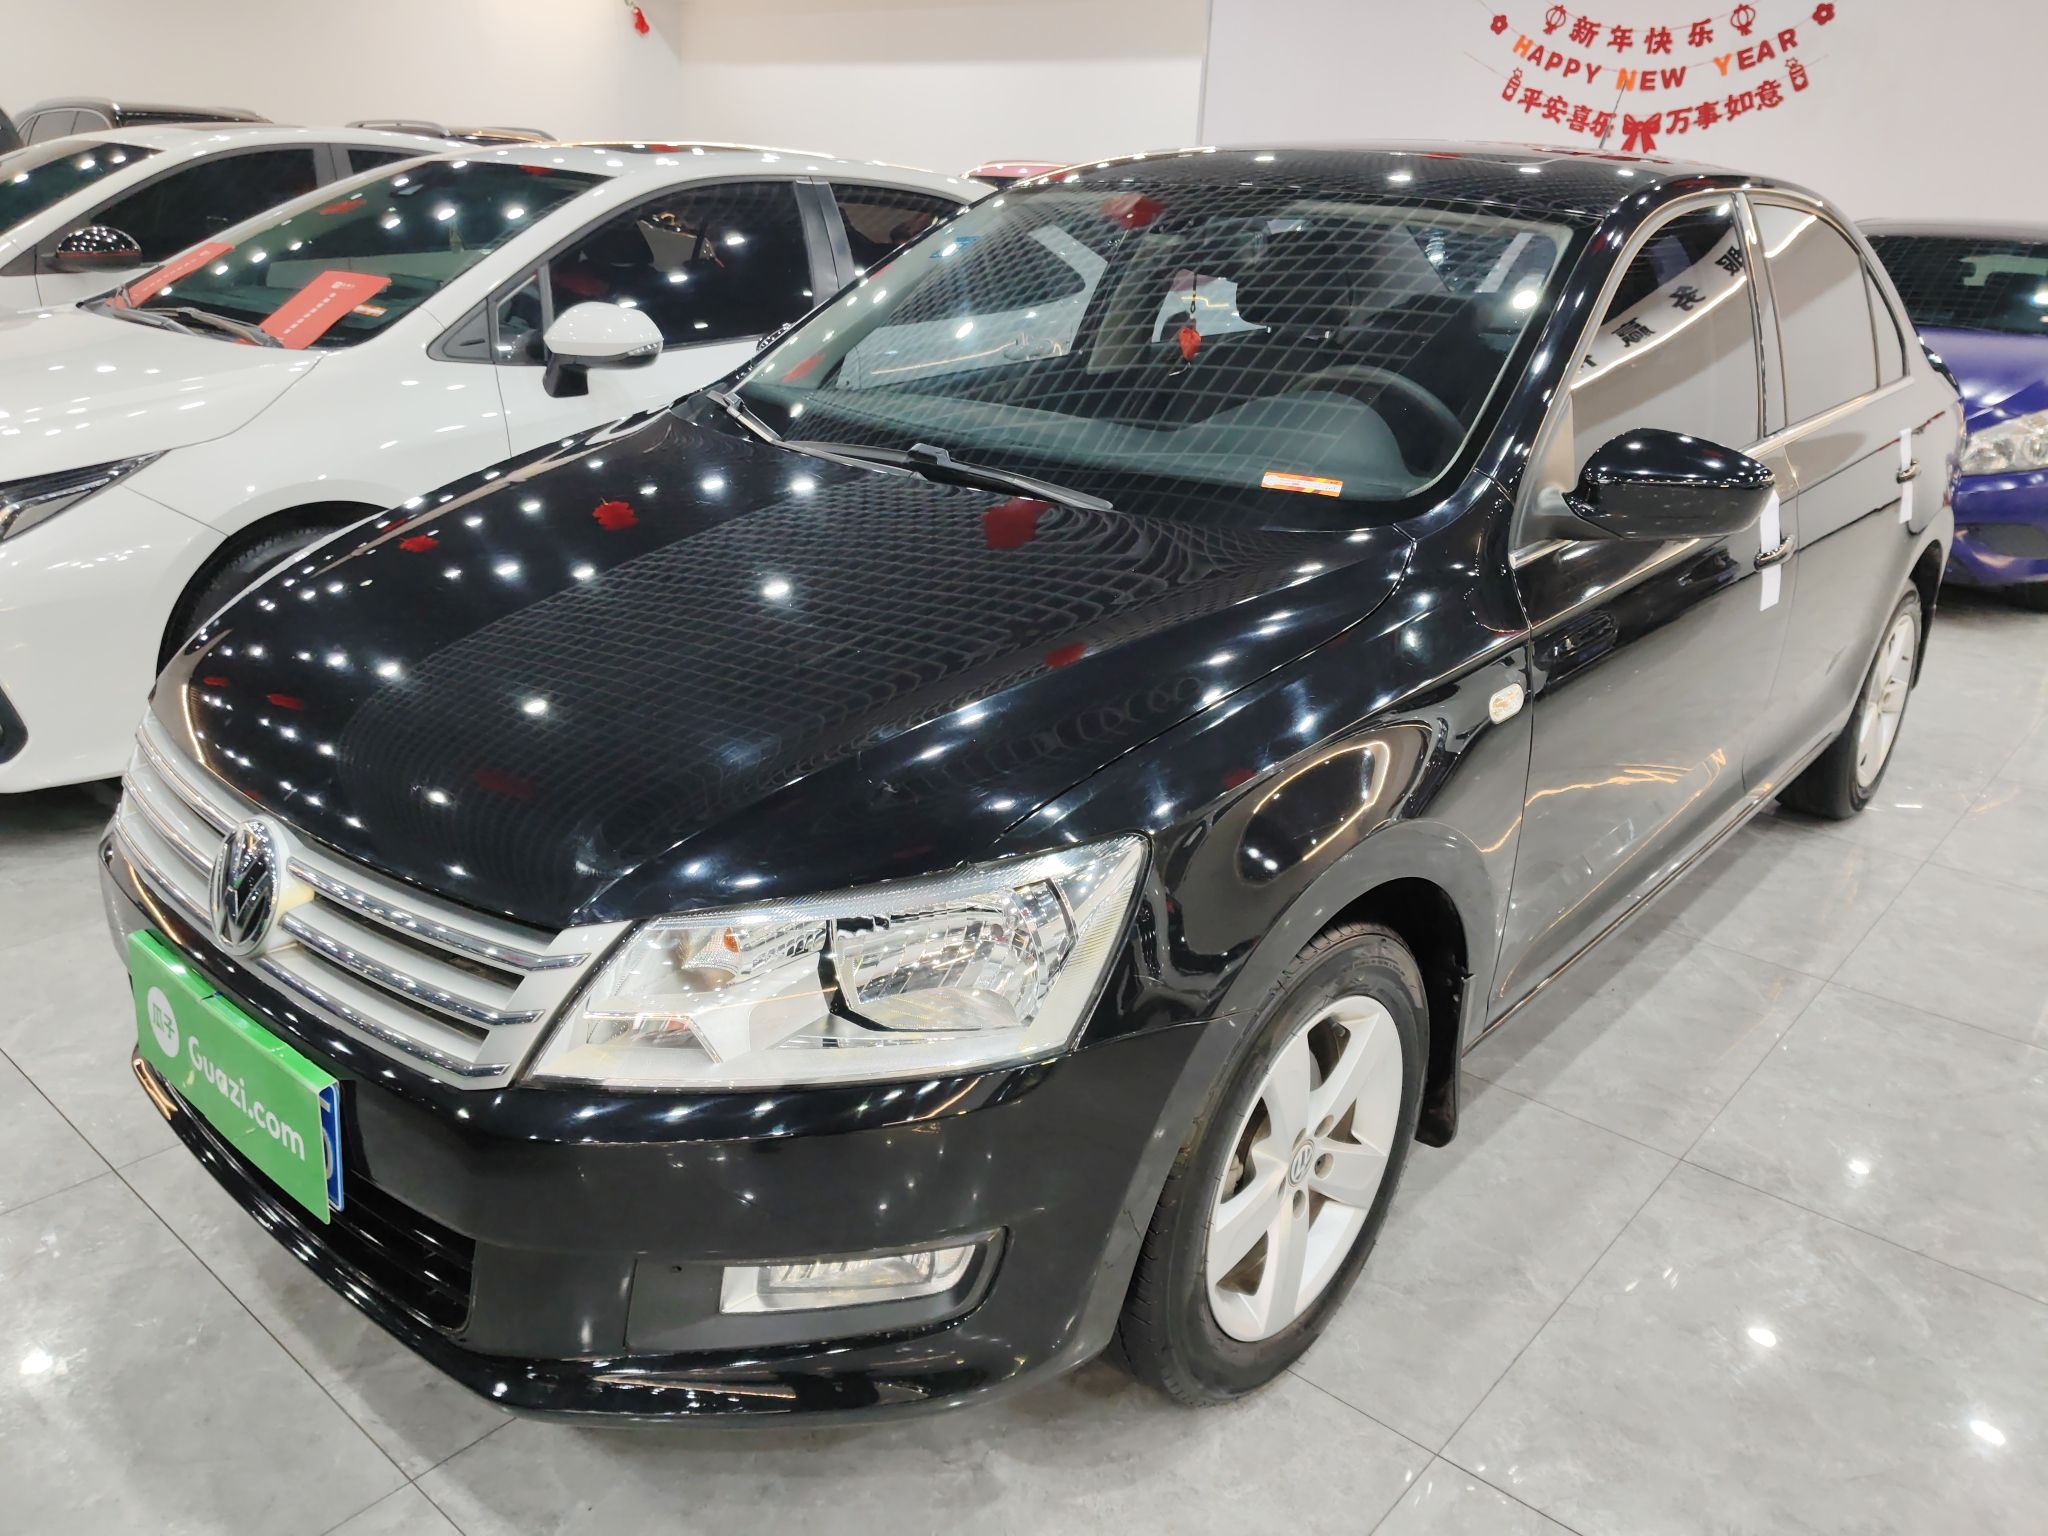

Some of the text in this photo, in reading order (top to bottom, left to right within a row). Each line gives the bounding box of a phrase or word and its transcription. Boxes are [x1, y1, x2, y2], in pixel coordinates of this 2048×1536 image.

[1512, 27, 1798, 92] HAPPY NEW YEAR
[1569, 16, 1714, 55] 新年快乐
[1517, 79, 1784, 138] 平安喜乐 万事如意
[188, 1036, 305, 1161] Guazi.com
